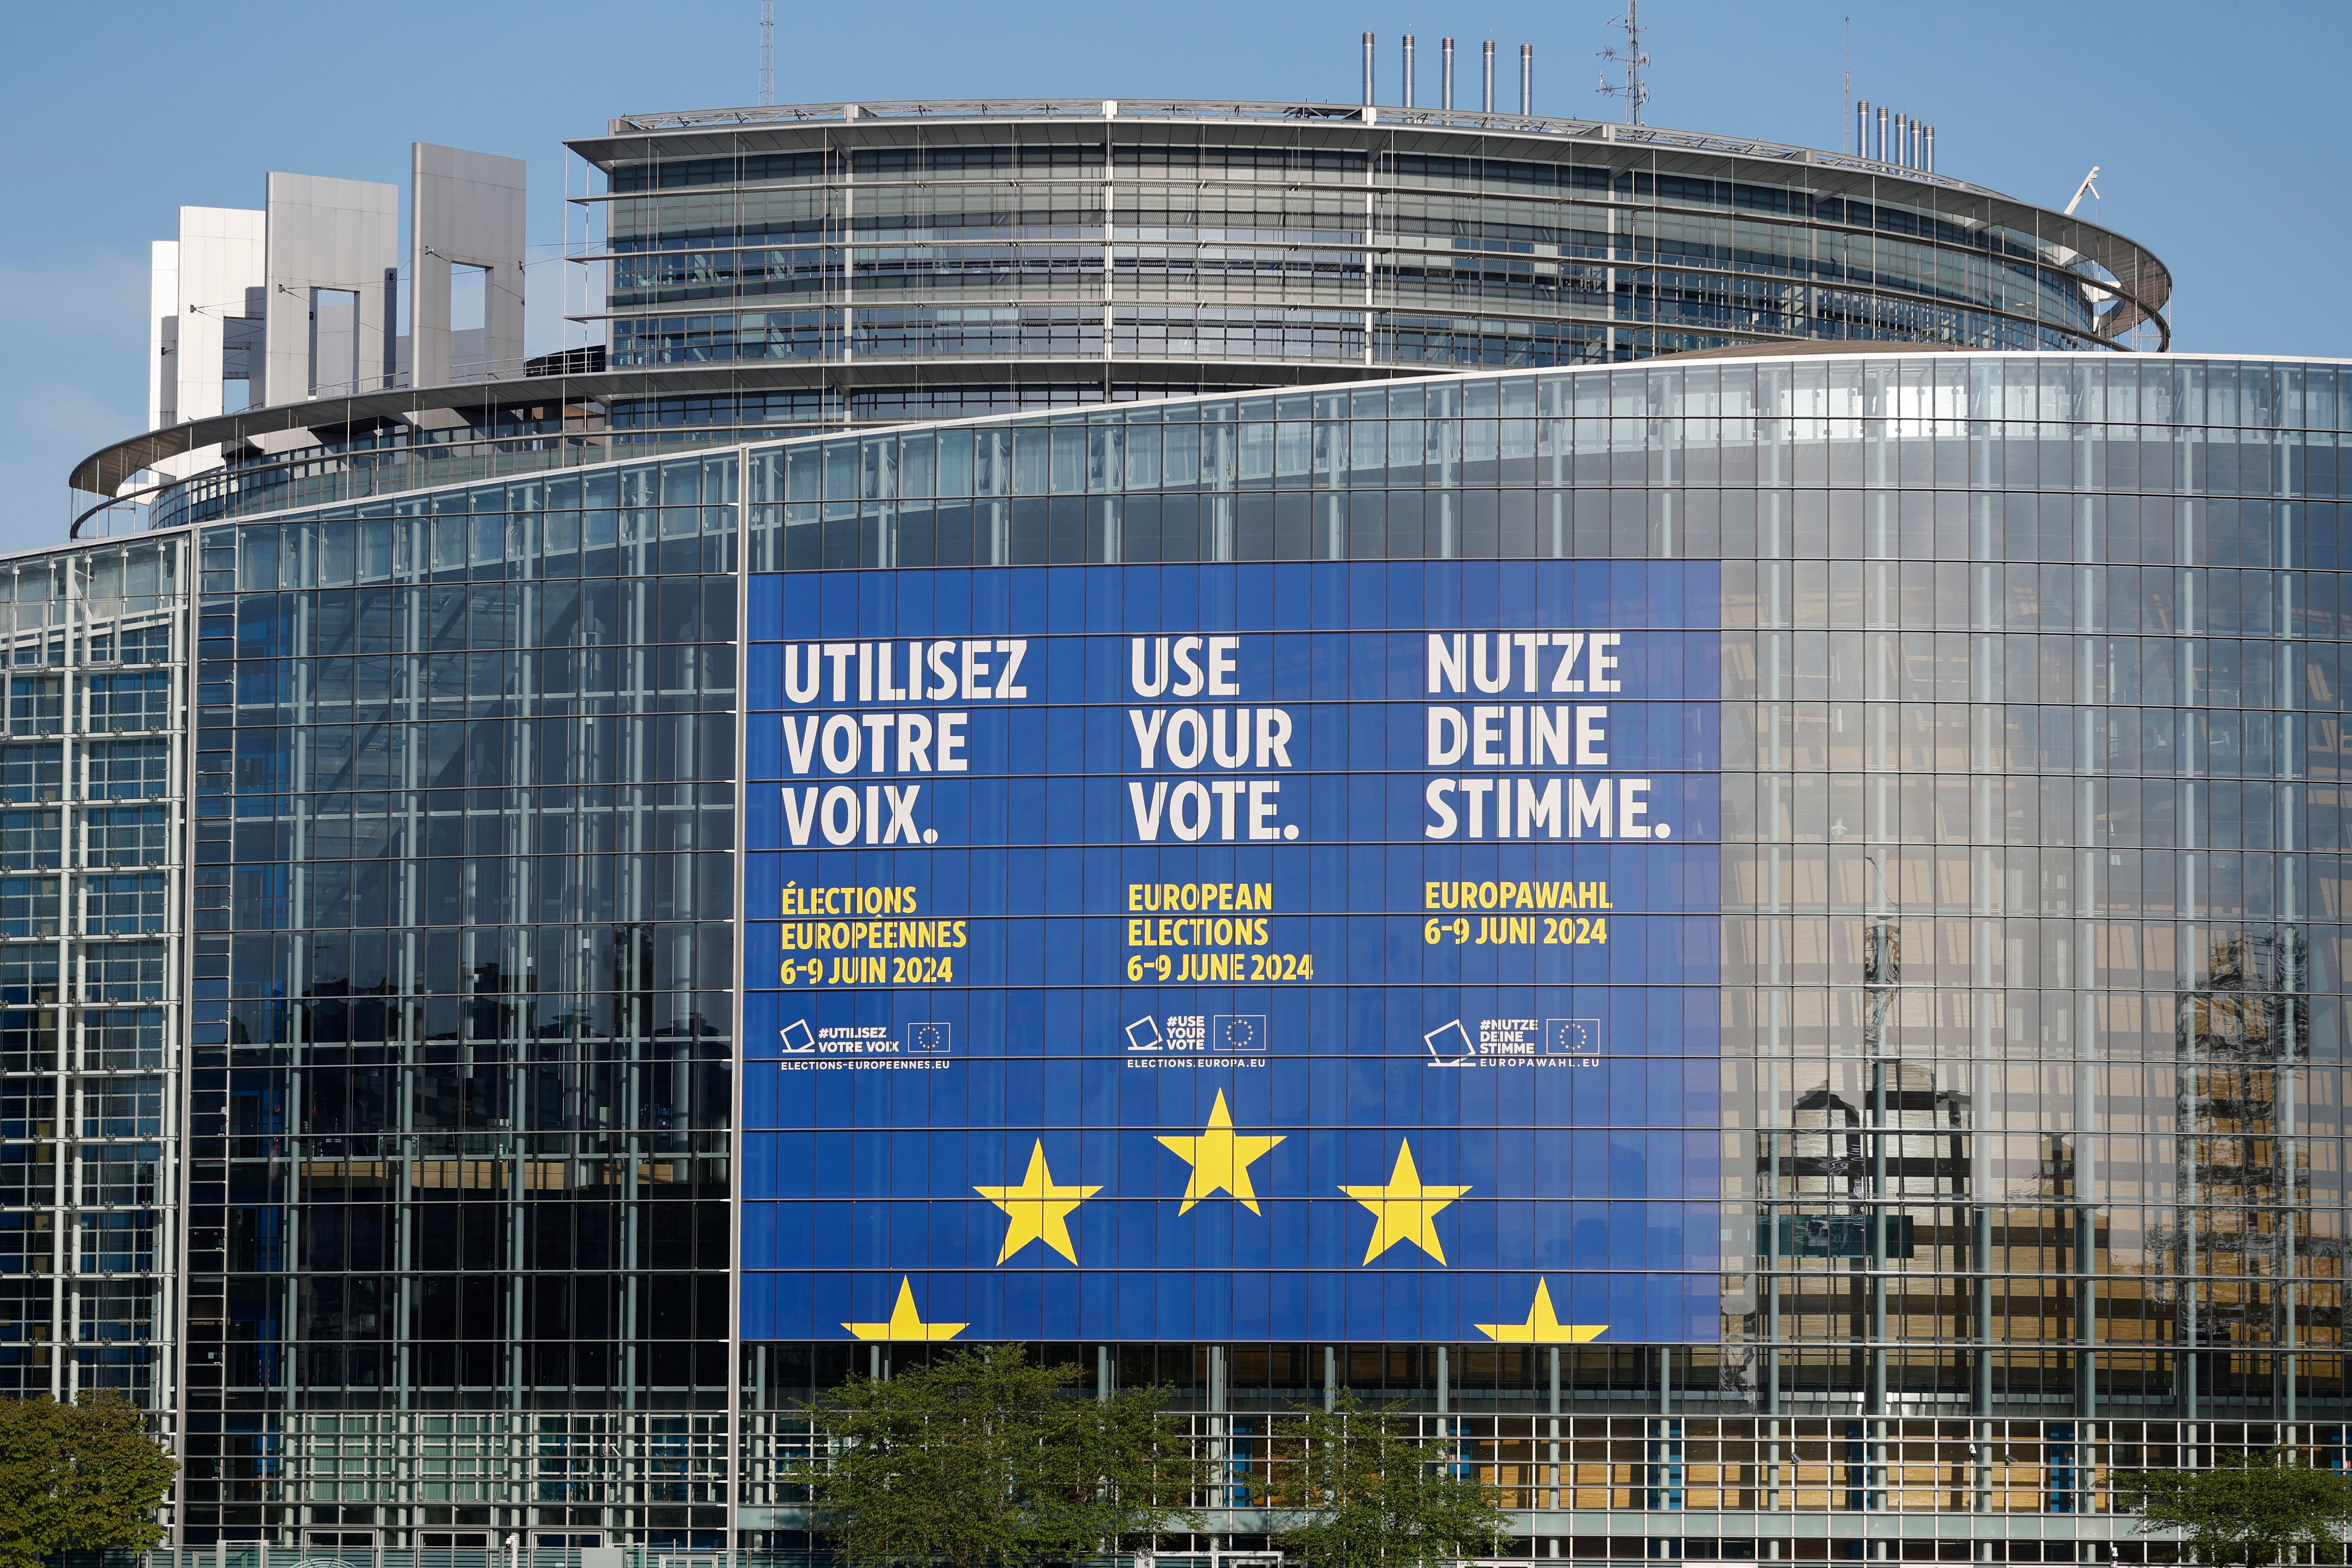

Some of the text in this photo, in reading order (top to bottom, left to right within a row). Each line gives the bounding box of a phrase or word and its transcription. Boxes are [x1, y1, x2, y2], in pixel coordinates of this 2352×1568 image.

[785, 640, 1027, 703] UTILISEZ
[1132, 637, 1239, 697] USE
[1428, 633, 1620, 693] NUTZE
[782, 713, 967, 774] VOTRE
[1129, 708, 1292, 769] YOUR
[1428, 706, 1607, 766] DEINE
[781, 785, 938, 845] VOIX.
[1128, 780, 1299, 841] VOTE.
[1425, 778, 1671, 839] STIMME.
[782, 880, 917, 915] ÉLECTIONS
[1129, 883, 1272, 911] EUROPEAN
[1426, 881, 1613, 909] EUROPAWAHL
[782, 914, 967, 950] EUROPÉENNES
[1129, 918, 1268, 946] ELECTIONS
[1424, 917, 1607, 944] 6-9 JUNI 2024
[781, 957, 953, 985] 6-9 JUIN 2024
[1127, 954, 1314, 981] 6-9 JUNE 2024
[819, 1027, 887, 1038] #UTILISEZ
[1166, 1015, 1205, 1027] #USE
[1166, 1028, 1205, 1038] YOUR
[1480, 1019, 1538, 1030] #NUTZE
[819, 1041, 900, 1053] VOTRE VOIX
[1166, 1039, 1204, 1050] VOTE
[1480, 1031, 1524, 1042] DEINE
[1480, 1043, 1535, 1054] STIMME
[781, 1060, 950, 1070] ELECTIONS-EUROPEENNES.EU
[1127, 1059, 1265, 1068] ELECTIONS.EUROPA.EU
[1480, 1058, 1599, 1067] EUROPAWAHL.EU
